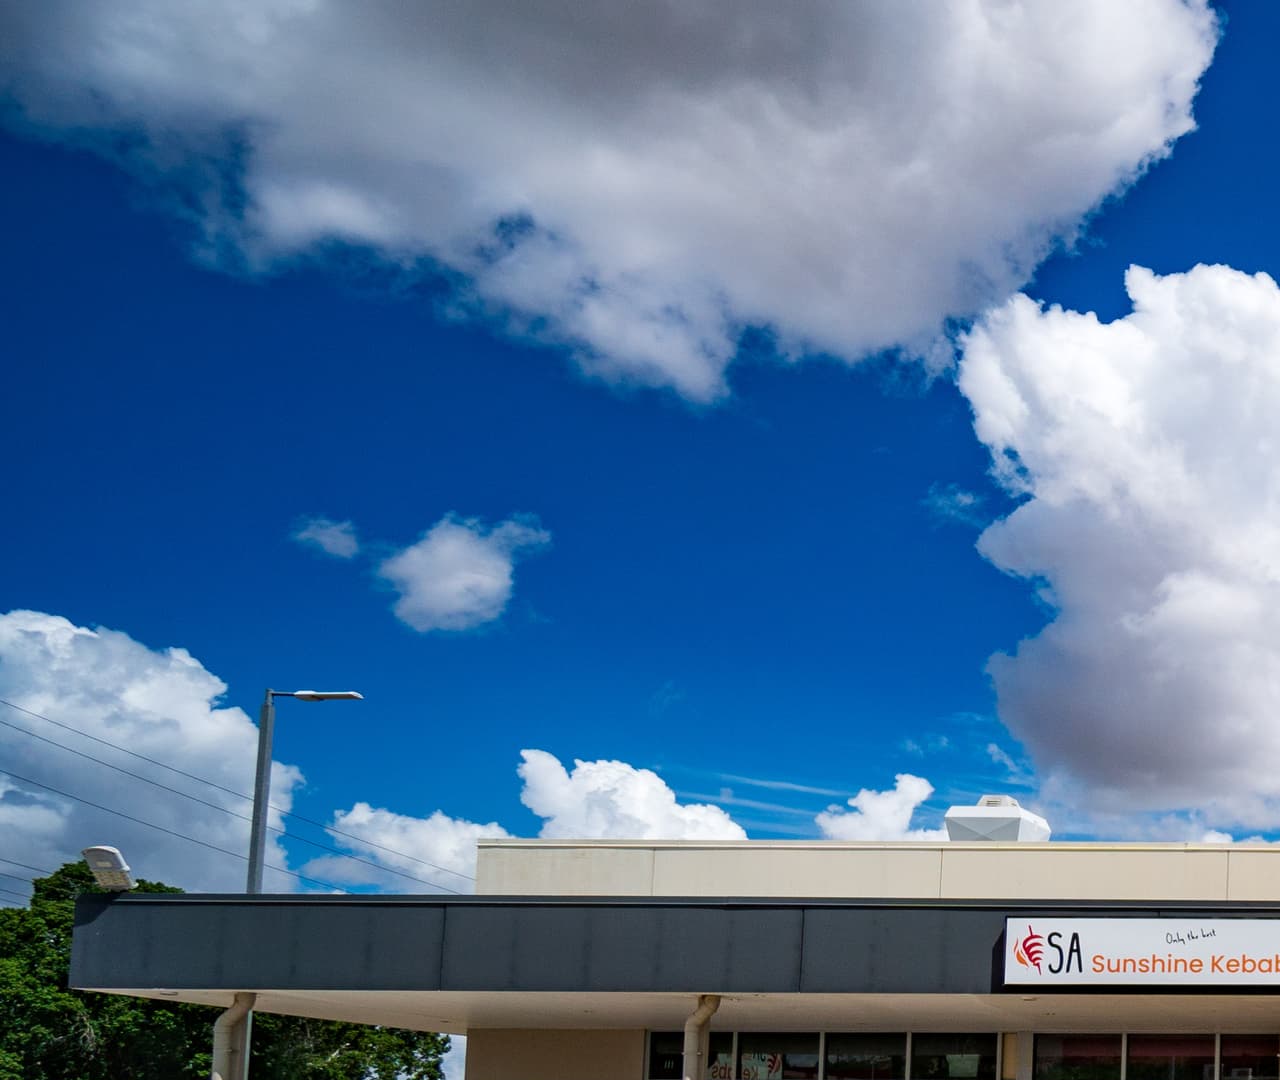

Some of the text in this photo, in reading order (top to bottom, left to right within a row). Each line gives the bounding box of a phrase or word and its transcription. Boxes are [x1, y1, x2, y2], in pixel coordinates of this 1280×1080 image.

[1166, 932, 1185, 945] Only
[1048, 932, 1082, 974] SA
[1092, 954, 1203, 974] Sunshine
